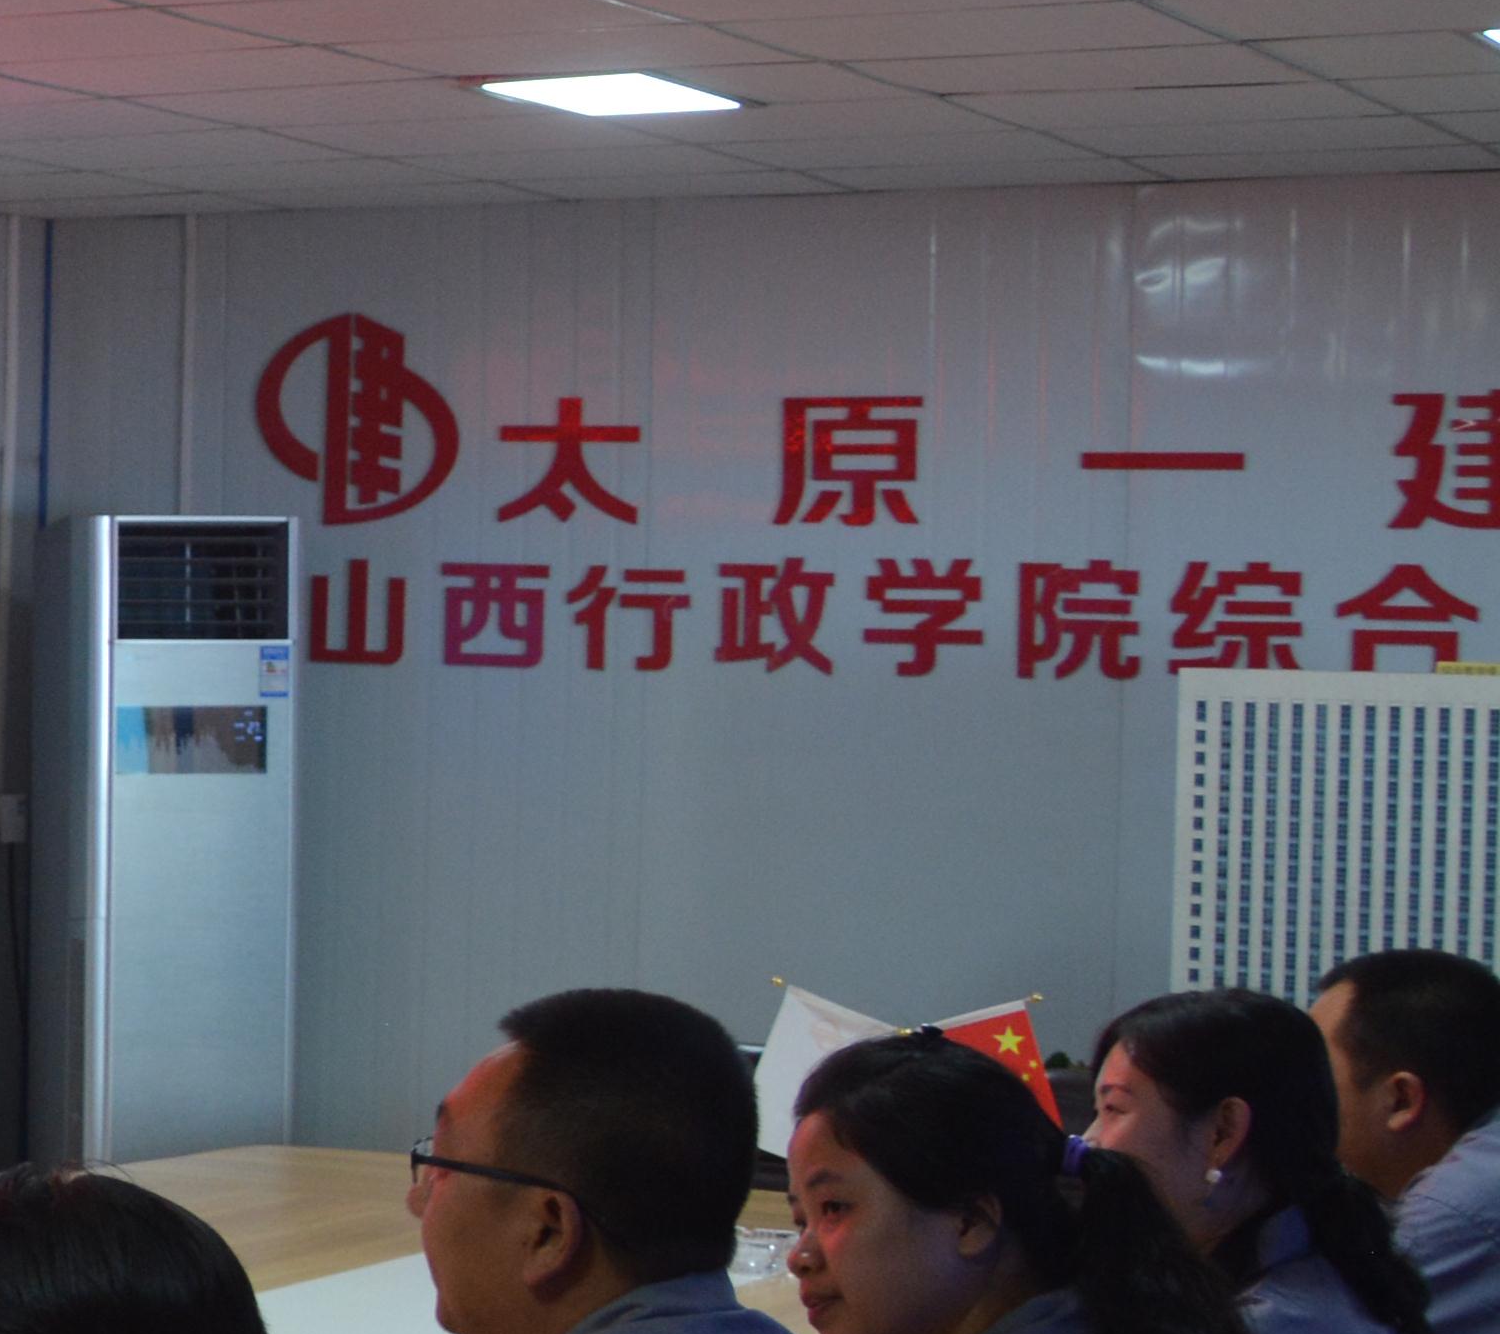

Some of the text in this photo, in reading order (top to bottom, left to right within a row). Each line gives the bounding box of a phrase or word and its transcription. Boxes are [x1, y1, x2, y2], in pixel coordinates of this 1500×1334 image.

[308, 556, 1481, 680] 山西行政学院综合
